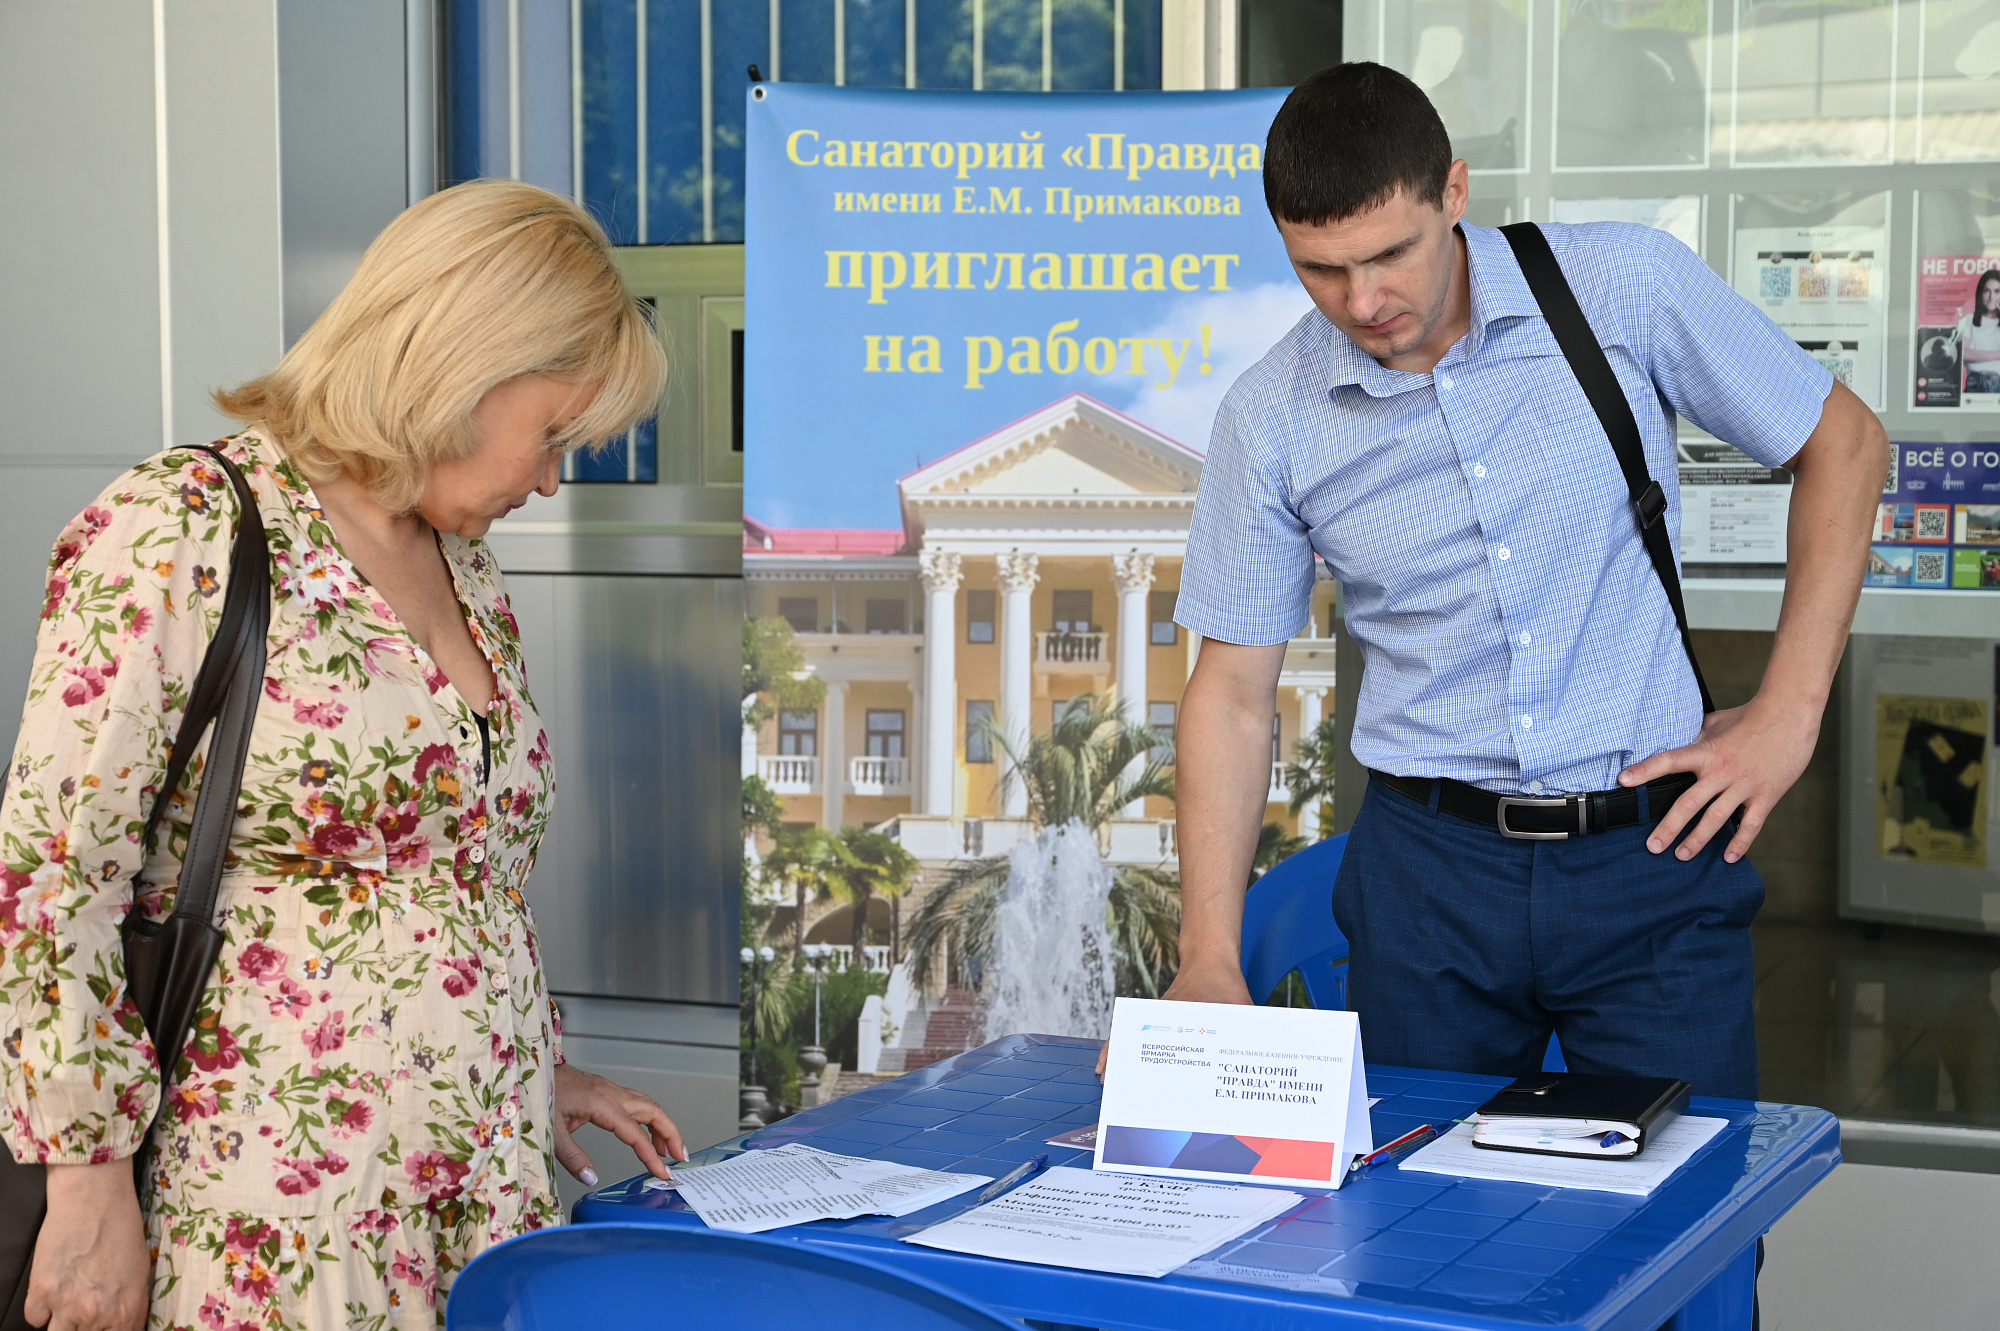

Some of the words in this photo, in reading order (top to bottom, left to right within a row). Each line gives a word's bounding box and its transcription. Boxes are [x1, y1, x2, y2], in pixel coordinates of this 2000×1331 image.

[786, 129, 1045, 178] Санаторий
[1061, 133, 1261, 179] «Правда
[834, 190, 941, 213] имени
[953, 187, 1031, 214] Е.М.
[1044, 187, 1241, 221] Примакова
[1923, 258, 1948, 275] НЕ
[825, 250, 1240, 304] приглашает
[863, 333, 943, 373] на
[963, 318, 1213, 390] работу!
[1905, 447, 1945, 467] ВСЁ
[1951, 451, 1967, 468] О
[1973, 451, 2000, 468] ГО
[1141, 1050, 1176, 1058] ЯРМАРКА
[1142, 1043, 1205, 1053] ВСЕРОССИЙСКАЯ
[1219, 1048, 1265, 1058] ФЕДЕРАЛЬНОЕ
[1266, 1051, 1299, 1060] КАЗЕННОЕ
[1300, 1054, 1344, 1063] УЧРЕЖДЕНИЕ
[1140, 1056, 1211, 1067] ТРУДОУСТРОЙСТВА
[1218, 1063, 1298, 1077] "САНАТОРИЙ
[1217, 1075, 1276, 1089] "ПРАВДА"
[1279, 1080, 1323, 1092] ИМЕНИ
[1215, 1088, 1238, 1099] Е.М.
[1241, 1090, 1317, 1105] ПРИМАКОВА
[1029, 1184, 1080, 1195] Повар
[1139, 1181, 1198, 1193] КАФЕ
[1015, 1191, 1101, 1206] Официант
